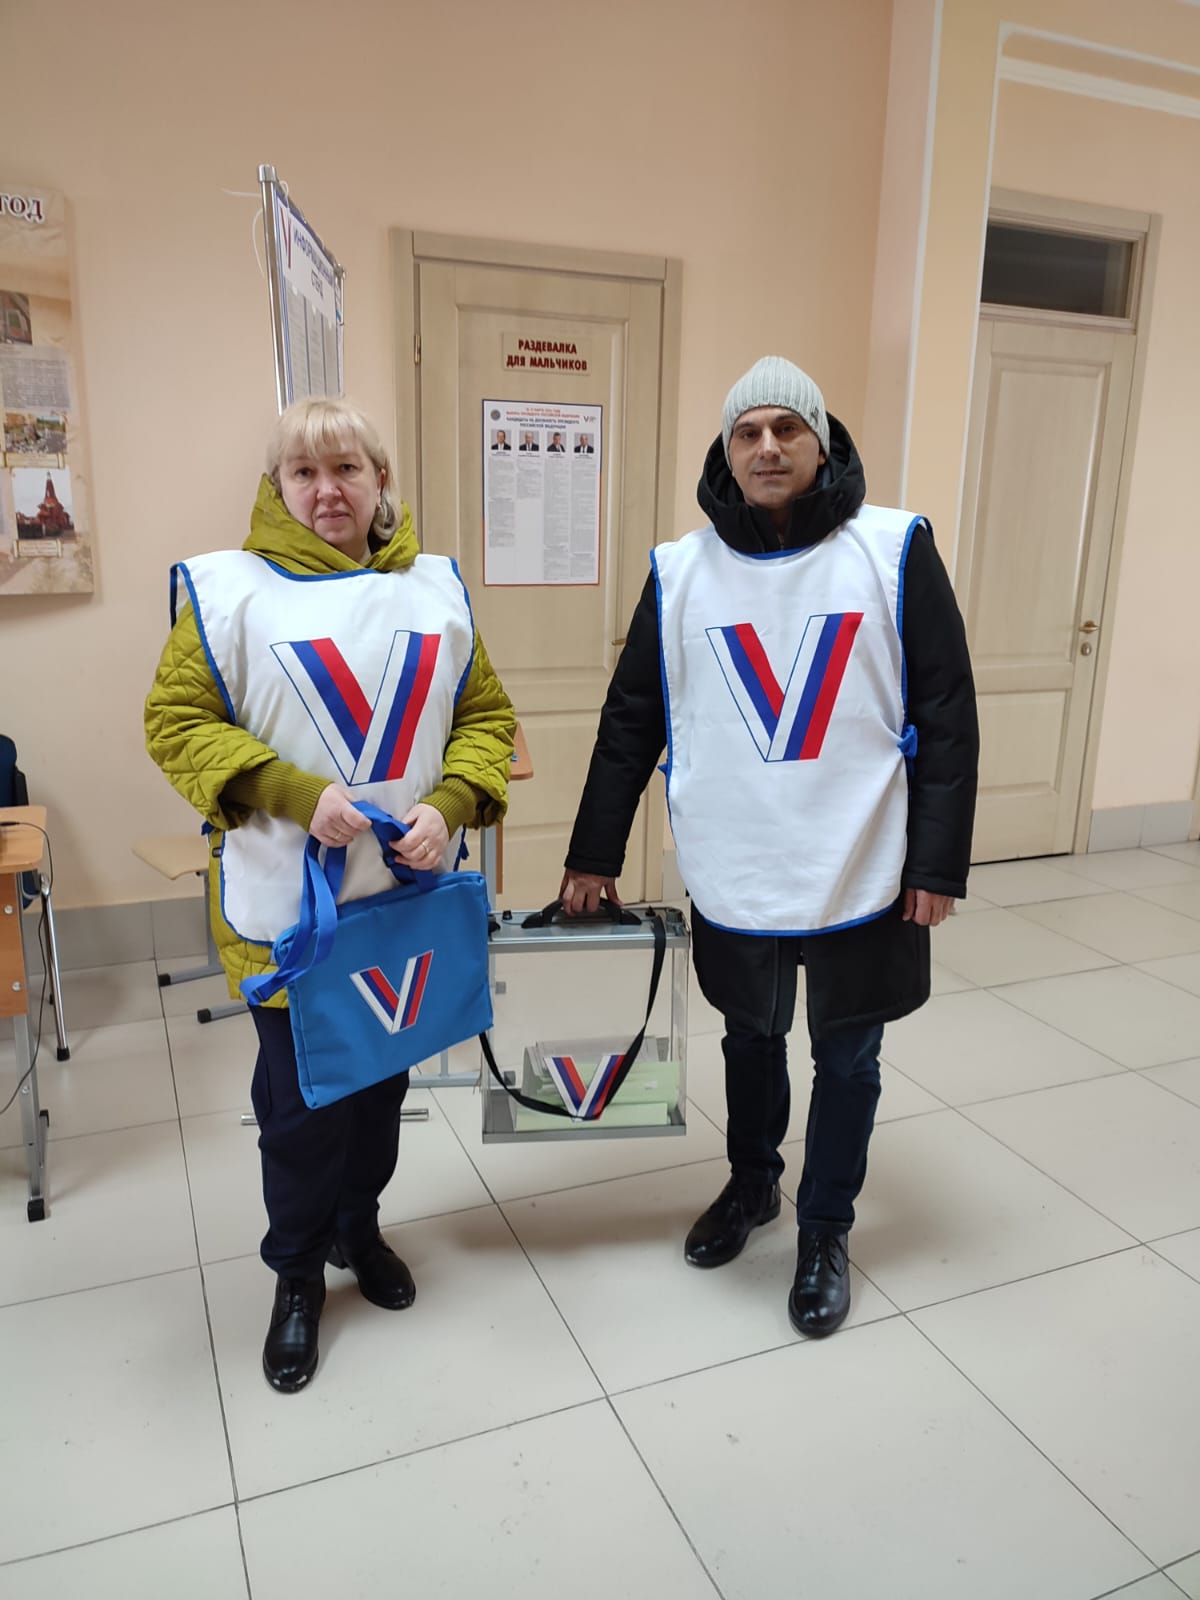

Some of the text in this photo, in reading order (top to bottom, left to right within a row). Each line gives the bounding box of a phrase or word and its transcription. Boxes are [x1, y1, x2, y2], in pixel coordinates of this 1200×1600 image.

[518, 339, 577, 354] РАЗДЕВАЛКА
[506, 354, 588, 371] ДЛЯ МАЛЬЧИКОВ
